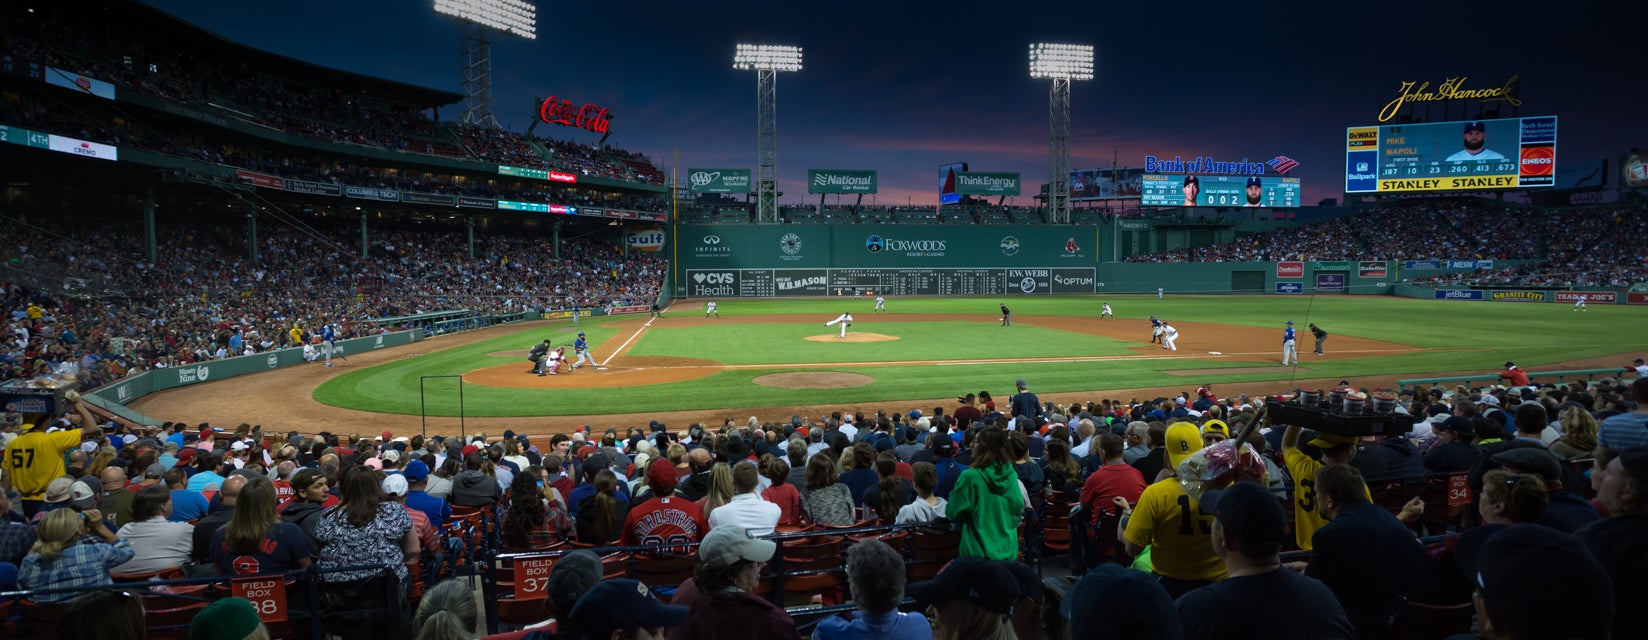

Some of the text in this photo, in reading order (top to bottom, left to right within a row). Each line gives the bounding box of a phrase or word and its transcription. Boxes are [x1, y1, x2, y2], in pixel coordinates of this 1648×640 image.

[1378, 74, 1521, 122] John Hancock
[31, 134, 48, 144] 4TH
[1386, 137, 1405, 145] MIKE
[74, 147, 96, 156] CREMO
[1386, 147, 1417, 155] NAPOLI
[1145, 155, 1265, 174] Bank of America
[1521, 157, 1552, 165] ENEOS
[1496, 163, 1515, 171] .673
[693, 172, 709, 185] AAA
[827, 174, 872, 185] National
[1382, 177, 1513, 190] STANLEY STANLEY
[379, 190, 398, 200] TECH
[1208, 196, 1238, 205] 0 0 2
[628, 233, 663, 244] Gulf
[885, 238, 946, 251] FOXWOODS
[706, 272, 734, 284] CVS
[1009, 269, 1049, 277] F.W. WEBB
[1063, 277, 1093, 285] OPTUM
[695, 285, 734, 296] Health
[1445, 290, 1472, 299] jetBlue
[1493, 291, 1544, 300] GRANITE CITY
[179, 374, 196, 383] Nine
[1181, 440, 1189, 451] B
[11, 449, 34, 468] 57
[1450, 488, 1467, 500] 34
[634, 508, 698, 539] NORDSTROM
[522, 559, 552, 568] FIELD
[526, 567, 548, 576] BOX
[242, 580, 276, 590] FIELD
[523, 577, 549, 592] 37
[246, 589, 272, 598] BOX
